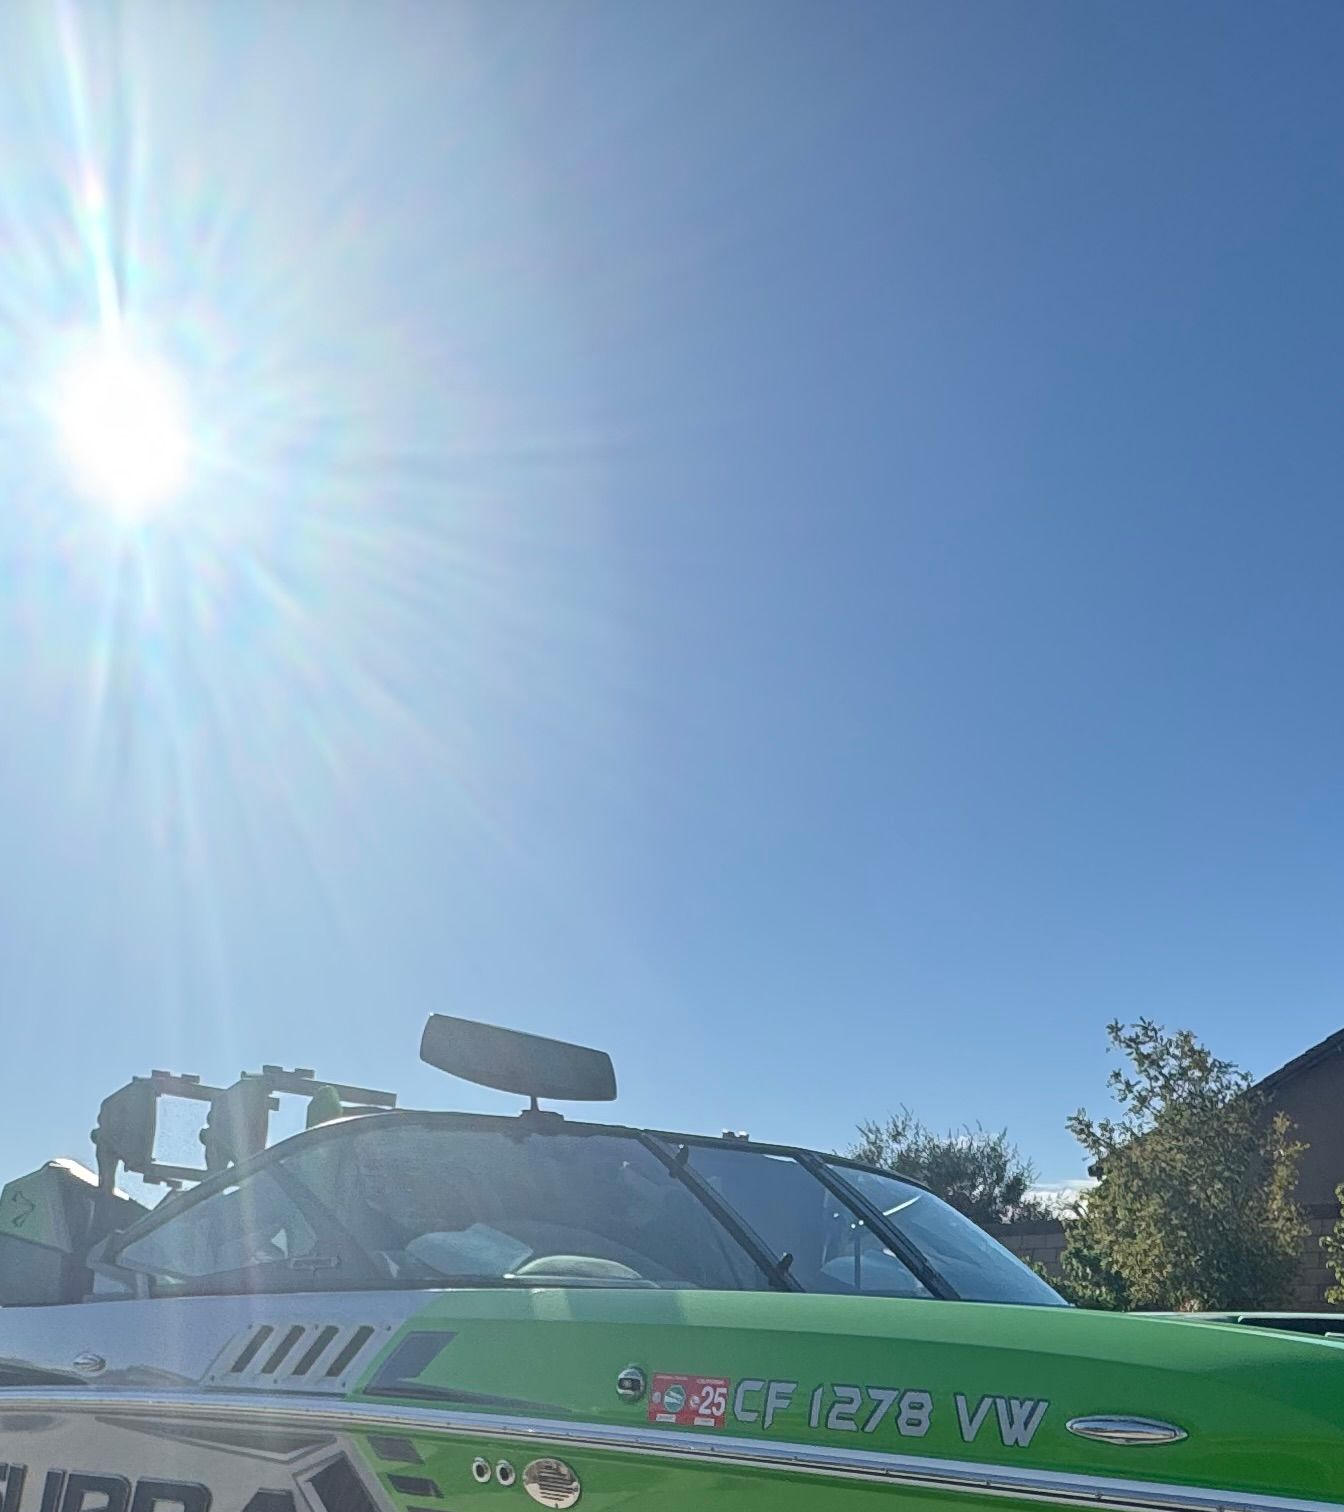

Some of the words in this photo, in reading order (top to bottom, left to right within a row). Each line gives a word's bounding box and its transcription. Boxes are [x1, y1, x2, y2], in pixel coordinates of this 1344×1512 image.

[698, 1385, 728, 1417] 25
[733, 1377, 799, 1430] CF
[807, 1383, 934, 1438] 1278
[953, 1391, 1051, 1448] VW
